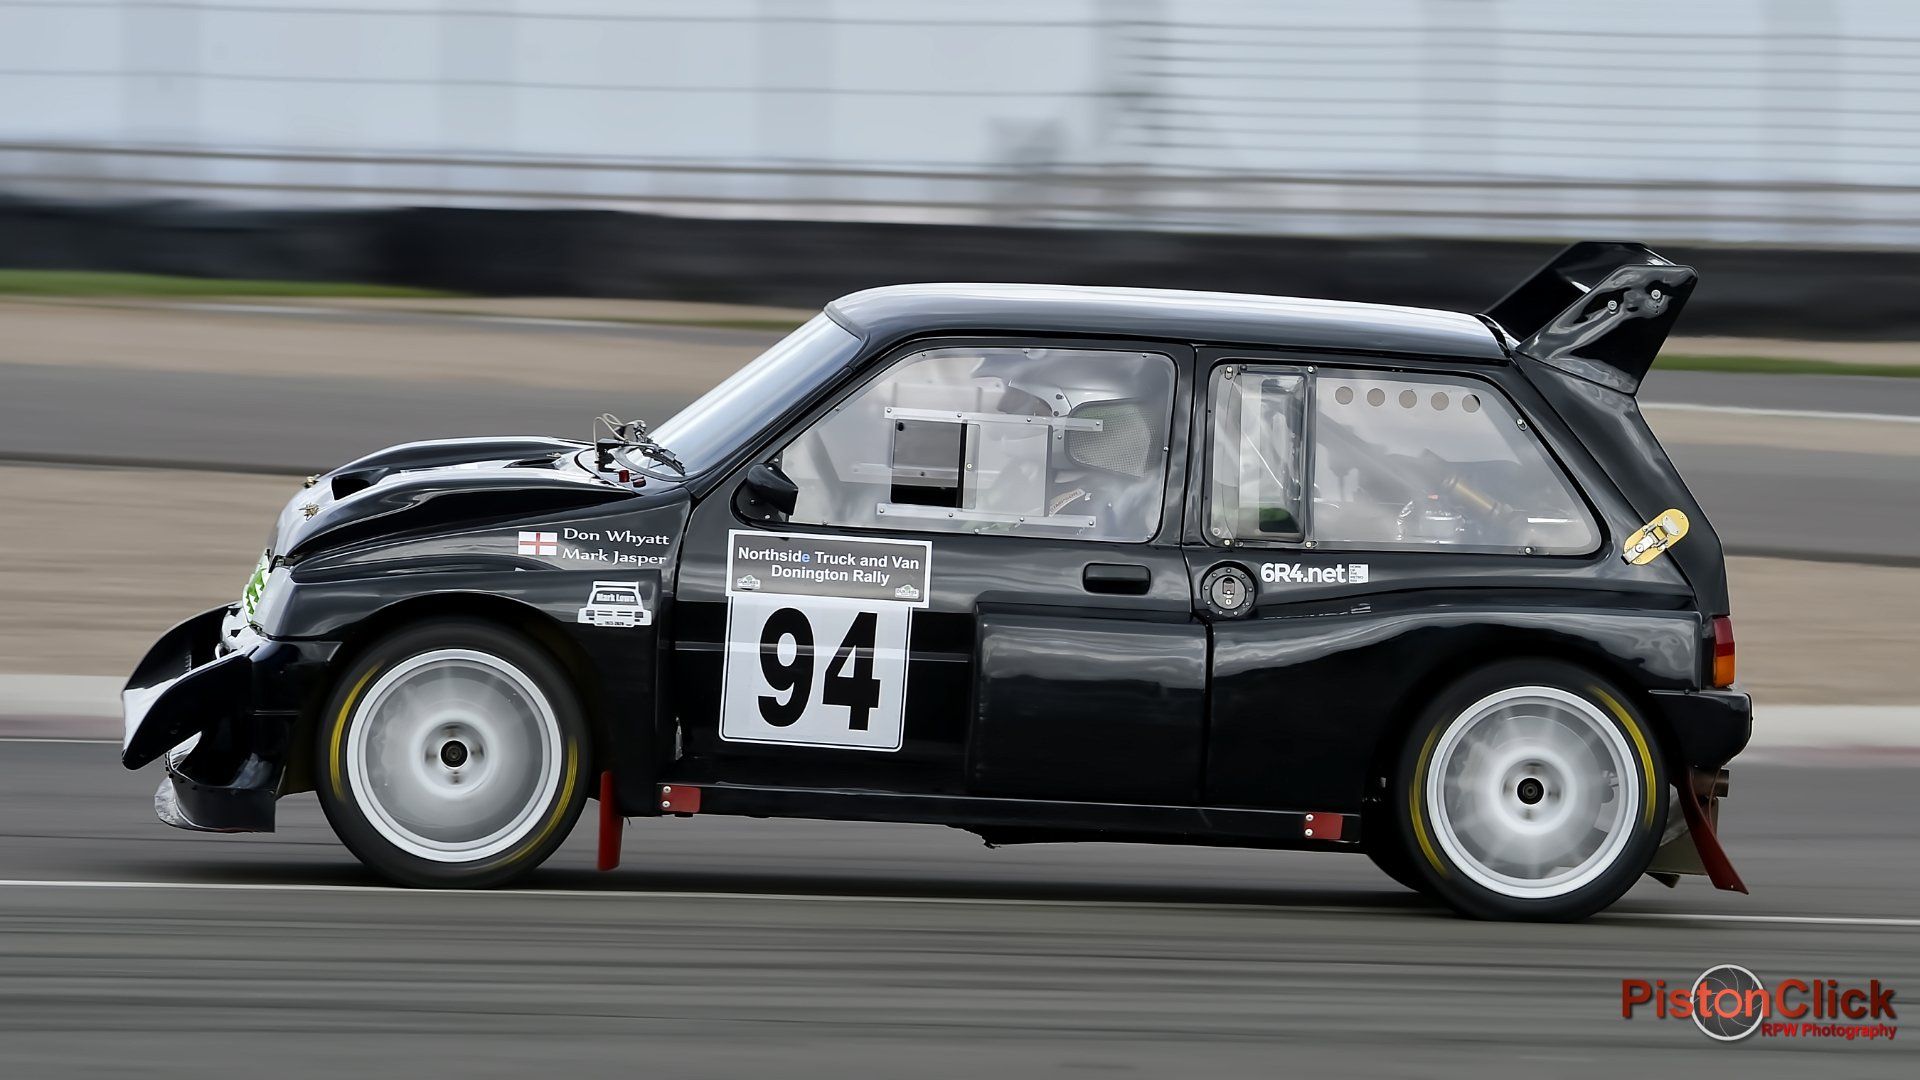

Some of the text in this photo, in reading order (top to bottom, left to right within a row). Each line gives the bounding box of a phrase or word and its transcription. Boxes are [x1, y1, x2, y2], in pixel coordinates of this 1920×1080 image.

[563, 527, 670, 547] Don Whyatt
[562, 548, 667, 567] Mark Jasper
[738, 546, 920, 570] Northside Truck and Van
[771, 565, 890, 586] Donington Rally
[1260, 562, 1347, 583] 6R4.net
[757, 607, 881, 731] 94
